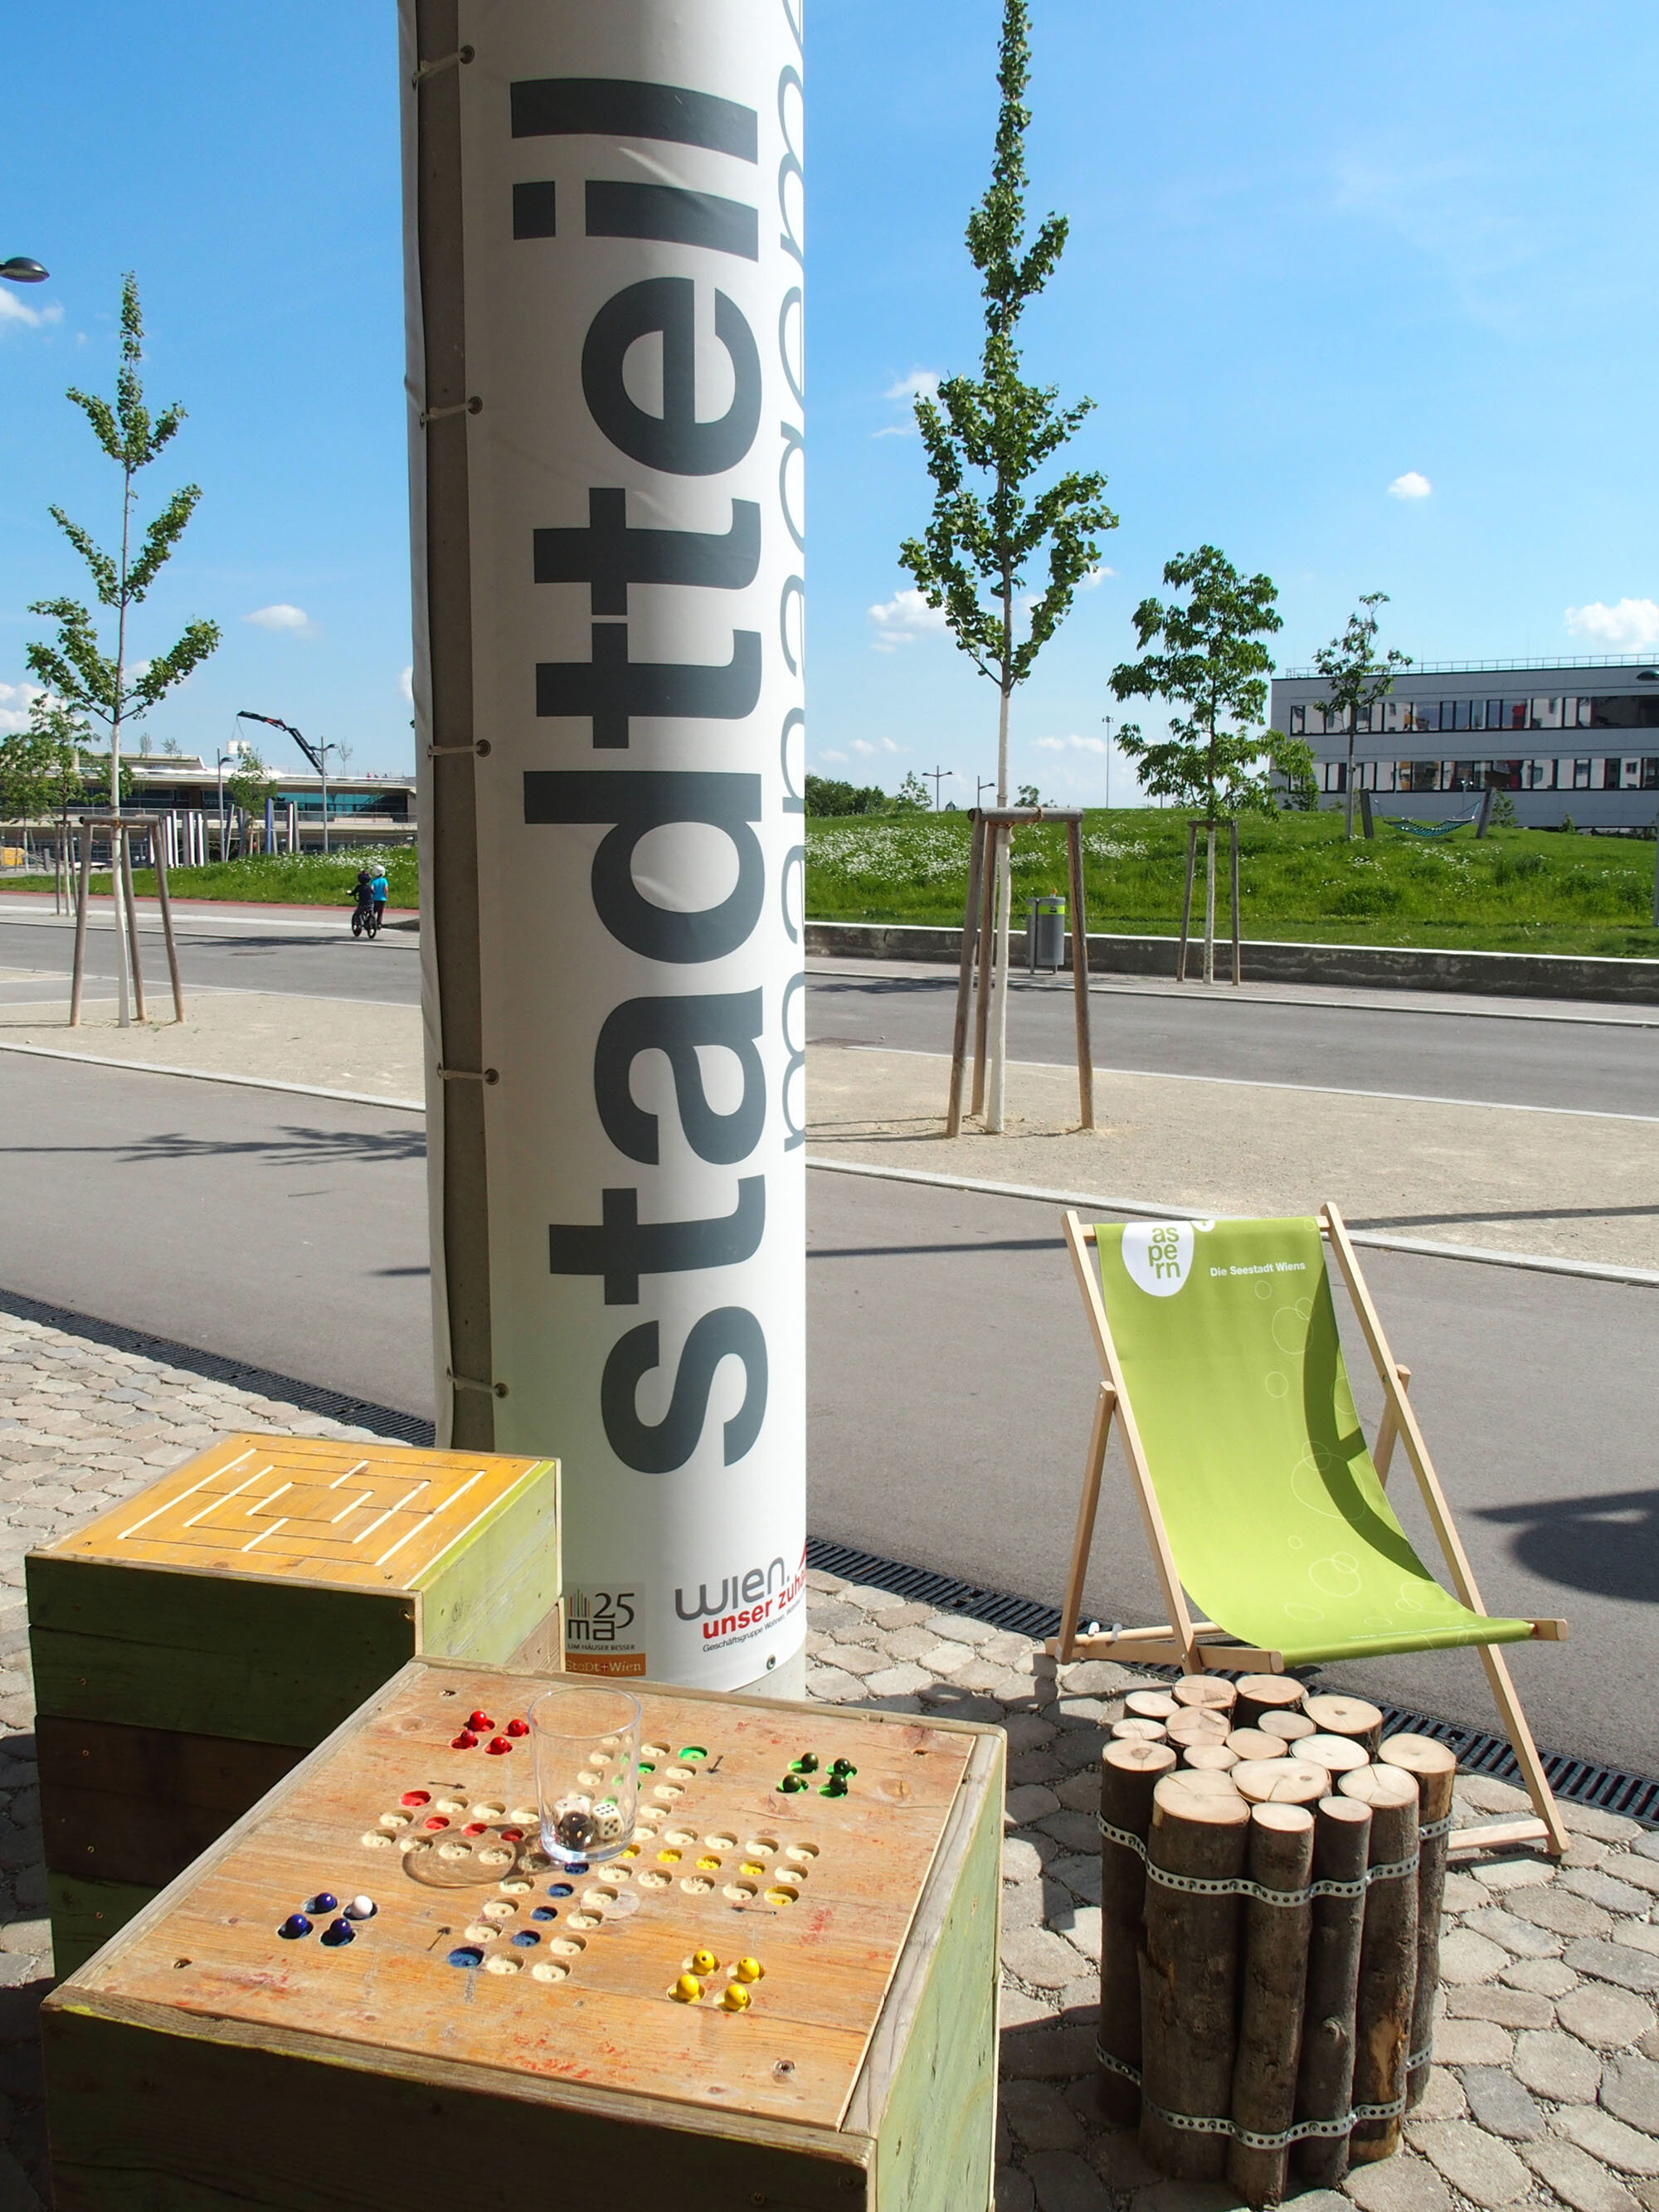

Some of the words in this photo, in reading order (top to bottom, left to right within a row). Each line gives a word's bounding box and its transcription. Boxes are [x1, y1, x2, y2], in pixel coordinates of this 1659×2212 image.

[510, 78, 768, 1474] stadtteil
[1209, 1267, 1227, 1277] Die
[1229, 1264, 1273, 1276] Seestadt
[1275, 1262, 1306, 1272] Wiens
[593, 1592, 635, 1629] 25
[703, 1599, 772, 1639] unser
[703, 1627, 763, 1652] Geschäftsgruppe
